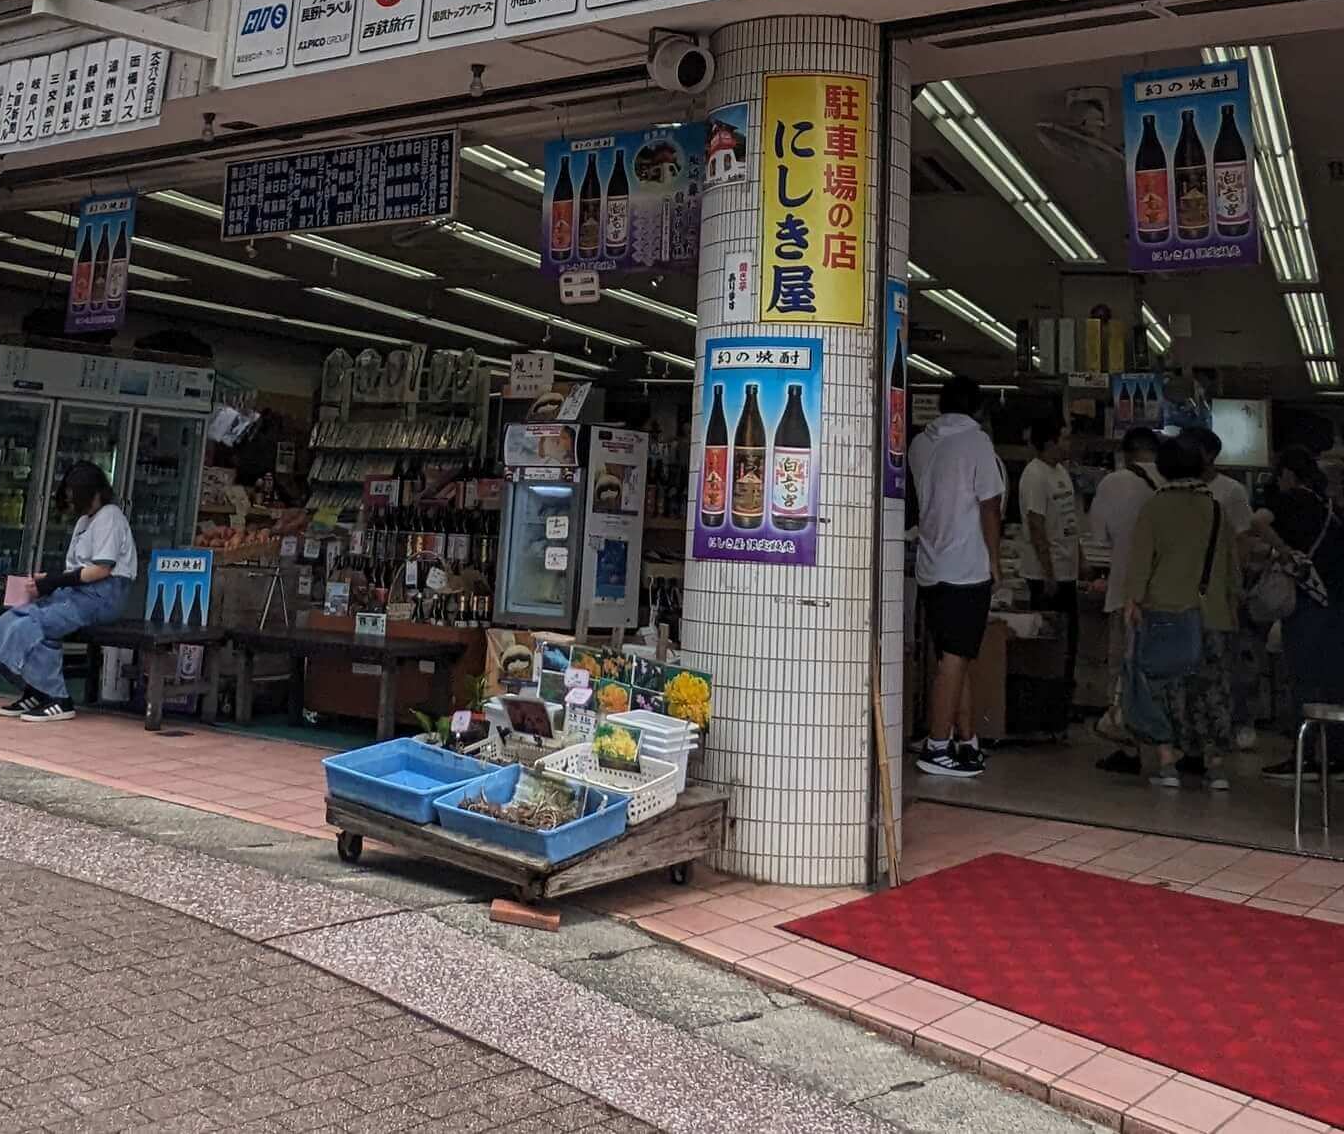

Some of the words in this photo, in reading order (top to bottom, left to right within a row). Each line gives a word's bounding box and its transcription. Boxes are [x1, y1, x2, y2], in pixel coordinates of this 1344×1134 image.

[300, 0, 353, 23] 長野トラベル
[362, 13, 417, 40] 西鉄旅行
[1145, 73, 1229, 96] 幻の焼酎
[821, 83, 861, 271] 駐車場の店
[766, 118, 818, 314] にしき屋
[717, 350, 802, 366] 幻の焼酎
